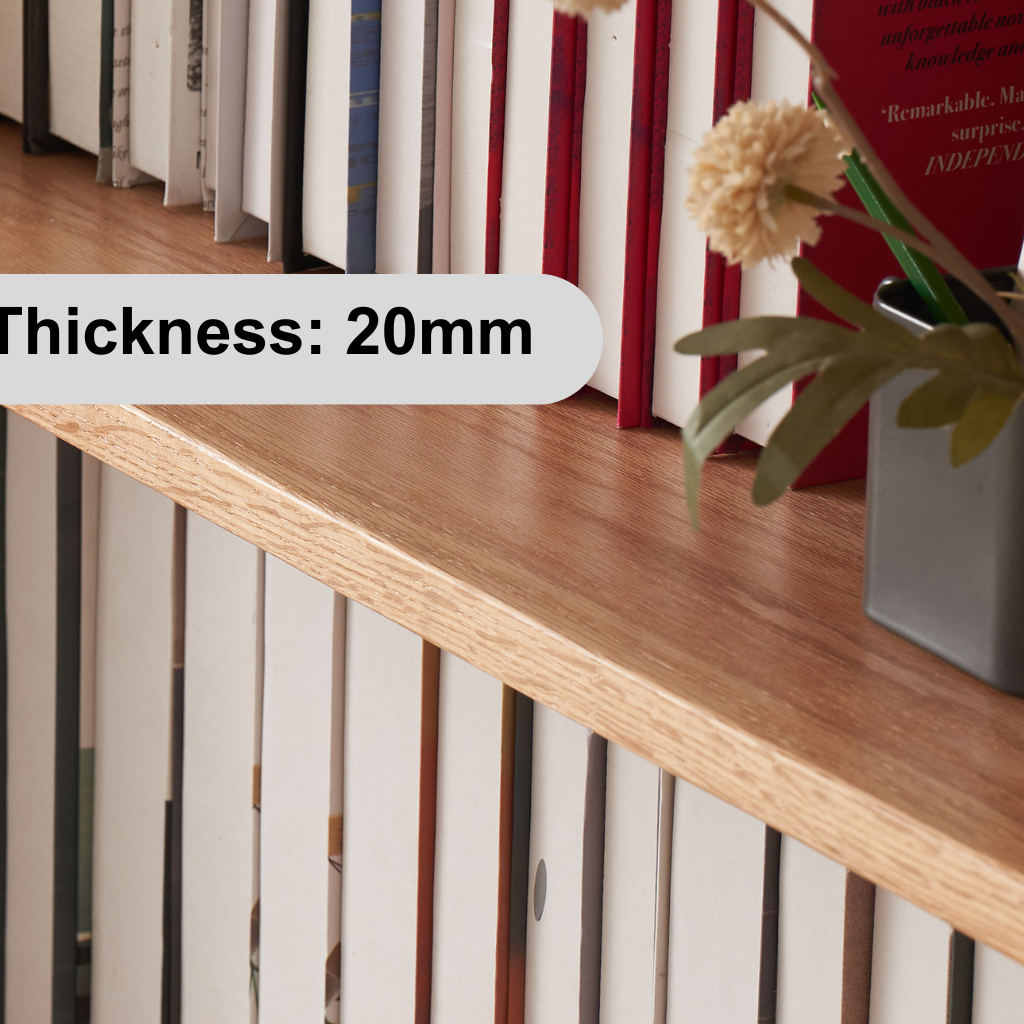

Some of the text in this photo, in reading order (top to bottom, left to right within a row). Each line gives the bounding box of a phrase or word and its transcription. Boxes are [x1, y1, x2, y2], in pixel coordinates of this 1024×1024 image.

[880, 11, 994, 51] unforgettable
[905, 41, 996, 72] knowledge
[881, 90, 995, 124] ‘Remarkable.
[925, 142, 1024, 176] INDEPEND
